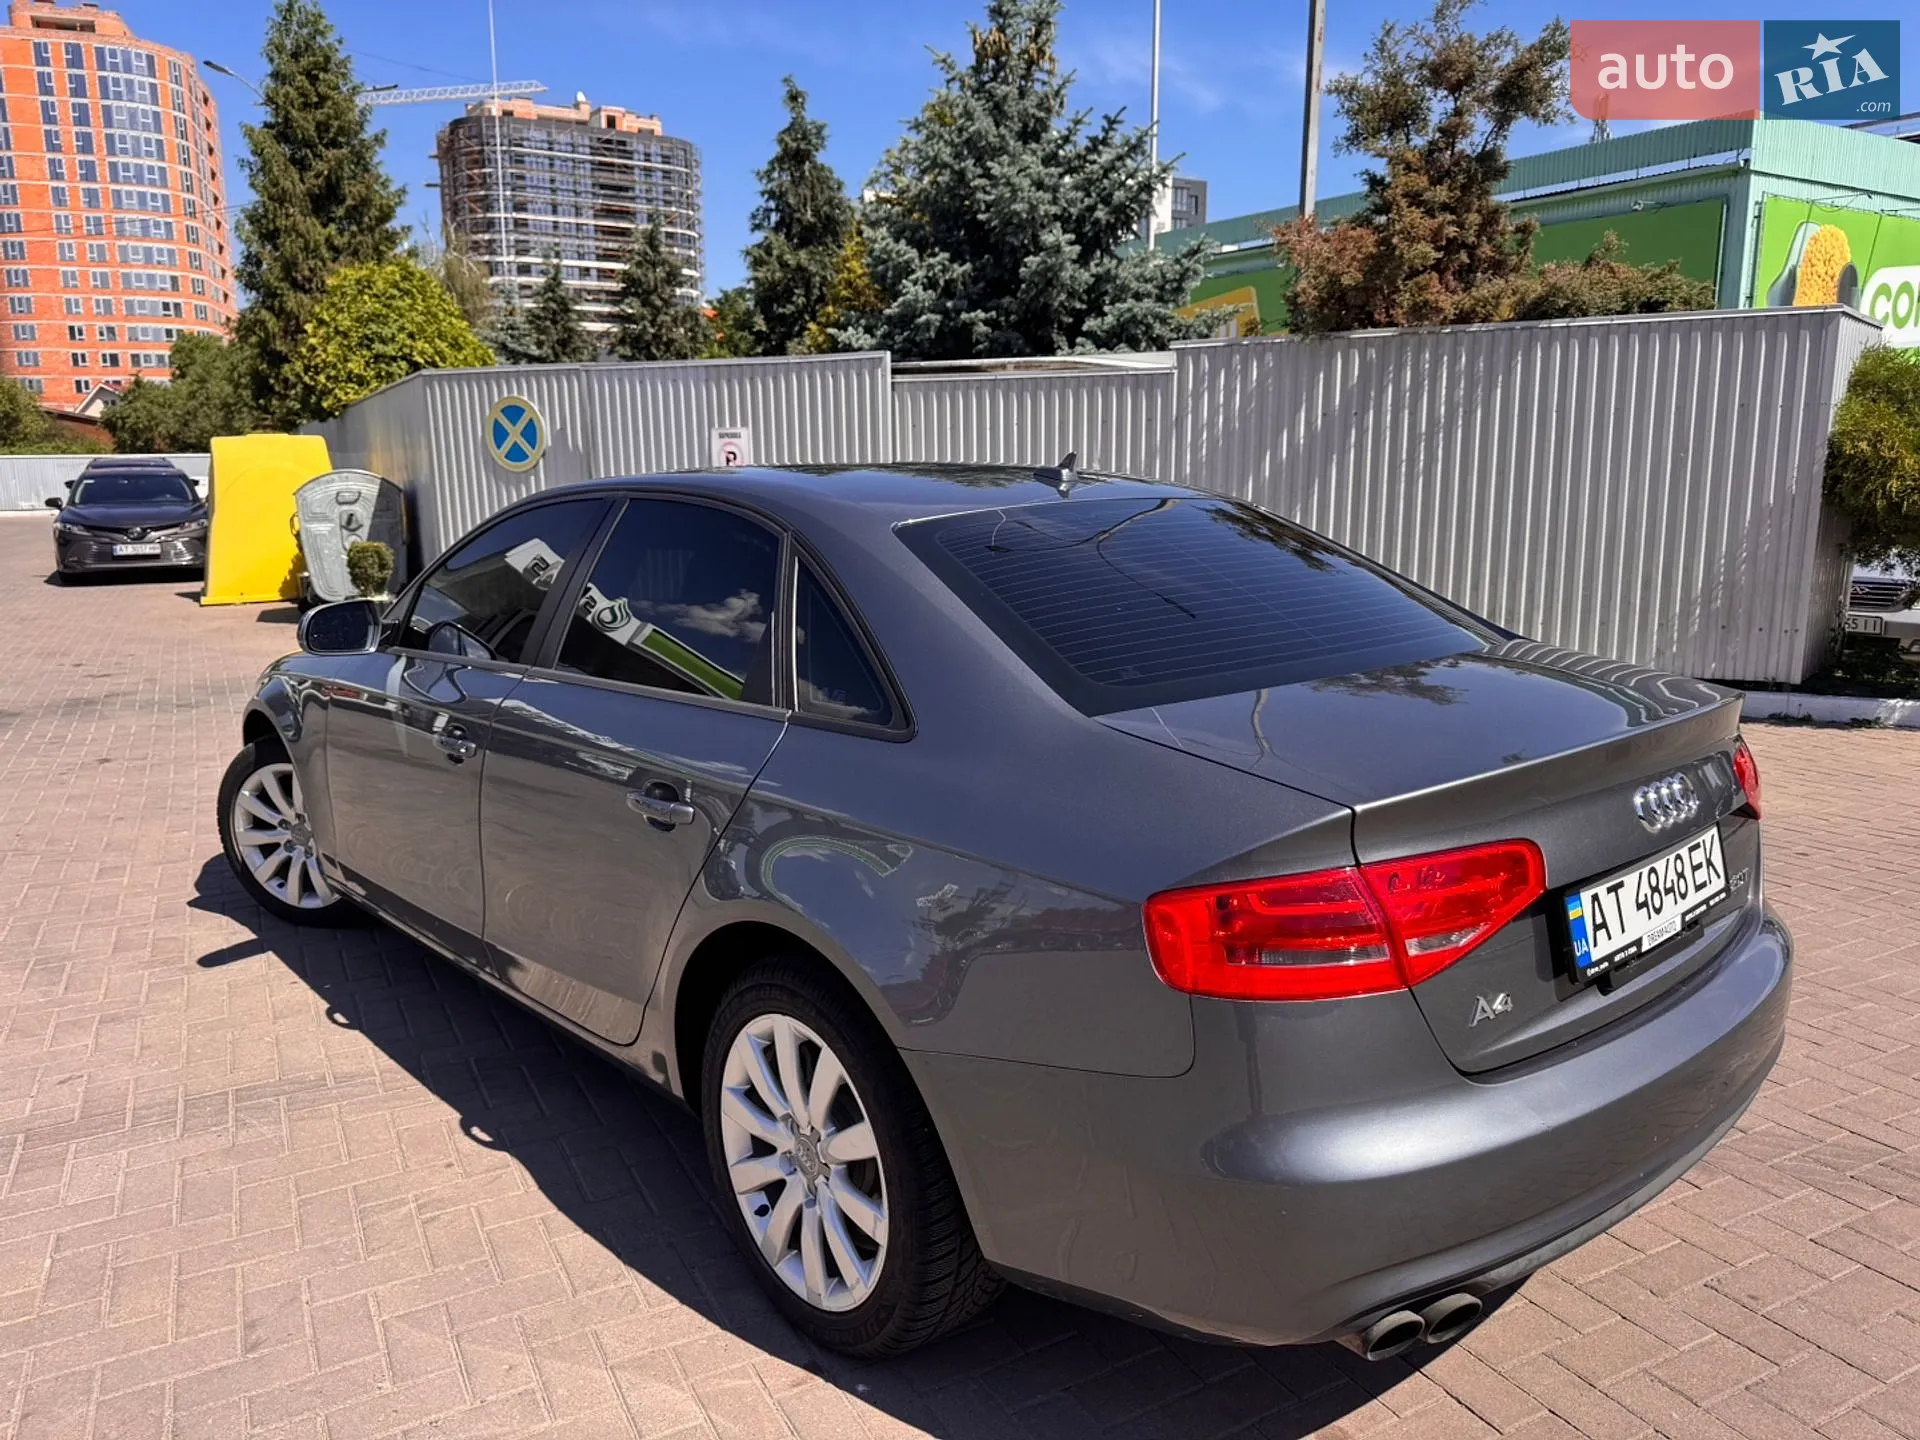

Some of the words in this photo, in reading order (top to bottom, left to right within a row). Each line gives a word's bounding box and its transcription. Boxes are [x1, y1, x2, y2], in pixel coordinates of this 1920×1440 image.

[1868, 280, 1920, 329] CO
[1590, 879, 1625, 949] AT
[1634, 852, 1689, 921] 4848
[1687, 833, 1721, 893] EK
[1573, 940, 1590, 957] UA
[1468, 992, 1514, 1029] A4
